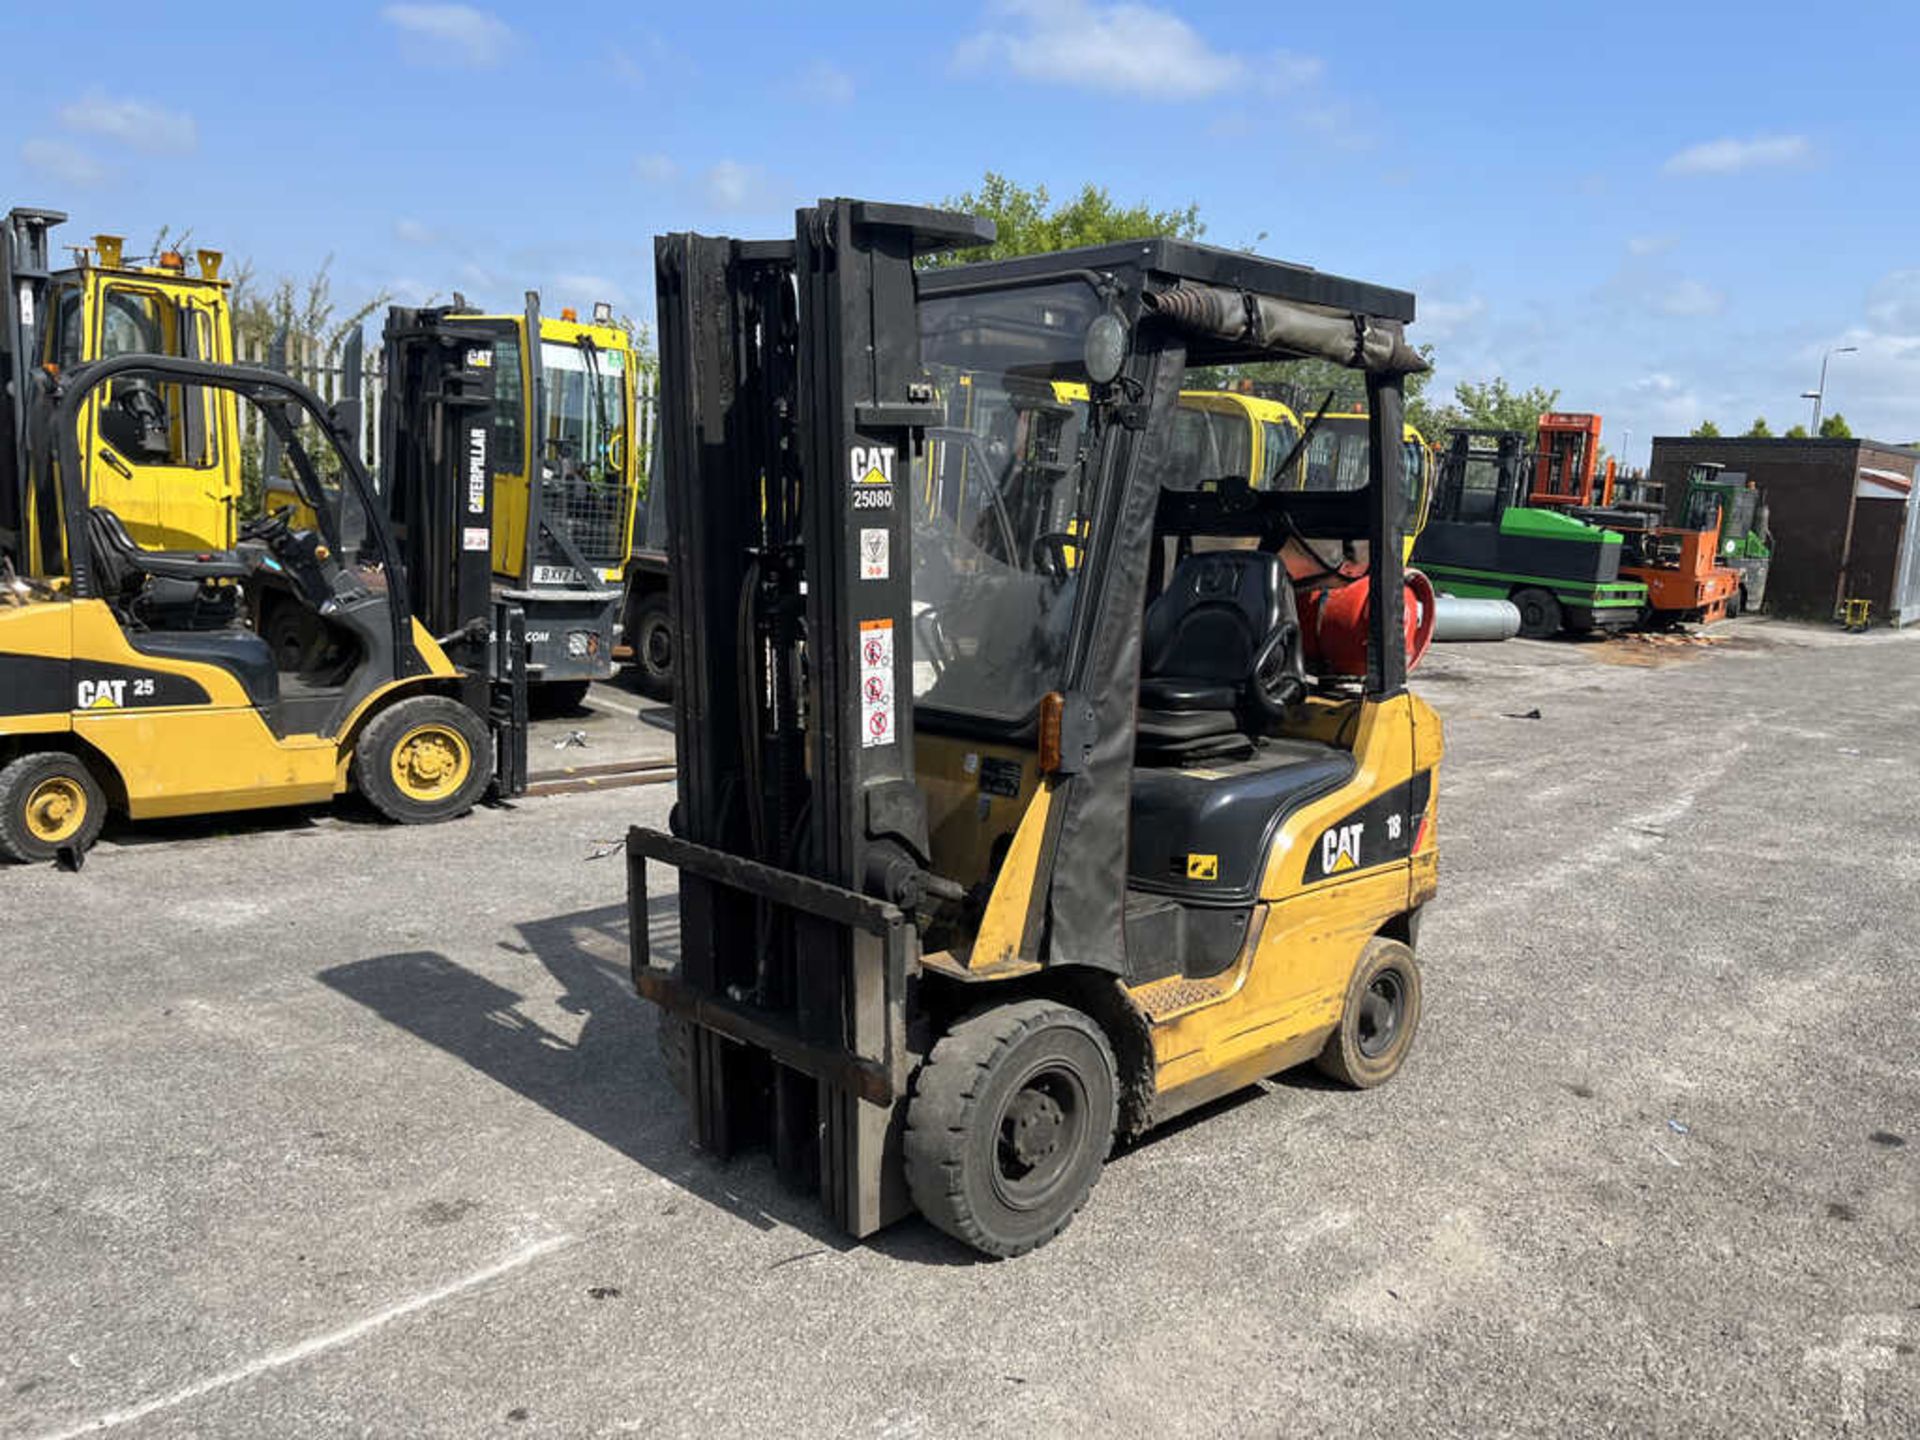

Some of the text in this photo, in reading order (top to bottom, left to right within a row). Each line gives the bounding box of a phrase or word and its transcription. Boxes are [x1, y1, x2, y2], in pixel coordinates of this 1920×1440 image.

[467, 349, 492, 367] CAT
[468, 428, 486, 513] CATERPILLAR
[850, 446, 895, 483] CAT
[853, 490, 892, 508] 25080
[78, 679, 155, 708] CAT 25
[1322, 814, 1401, 874] CAT 18
